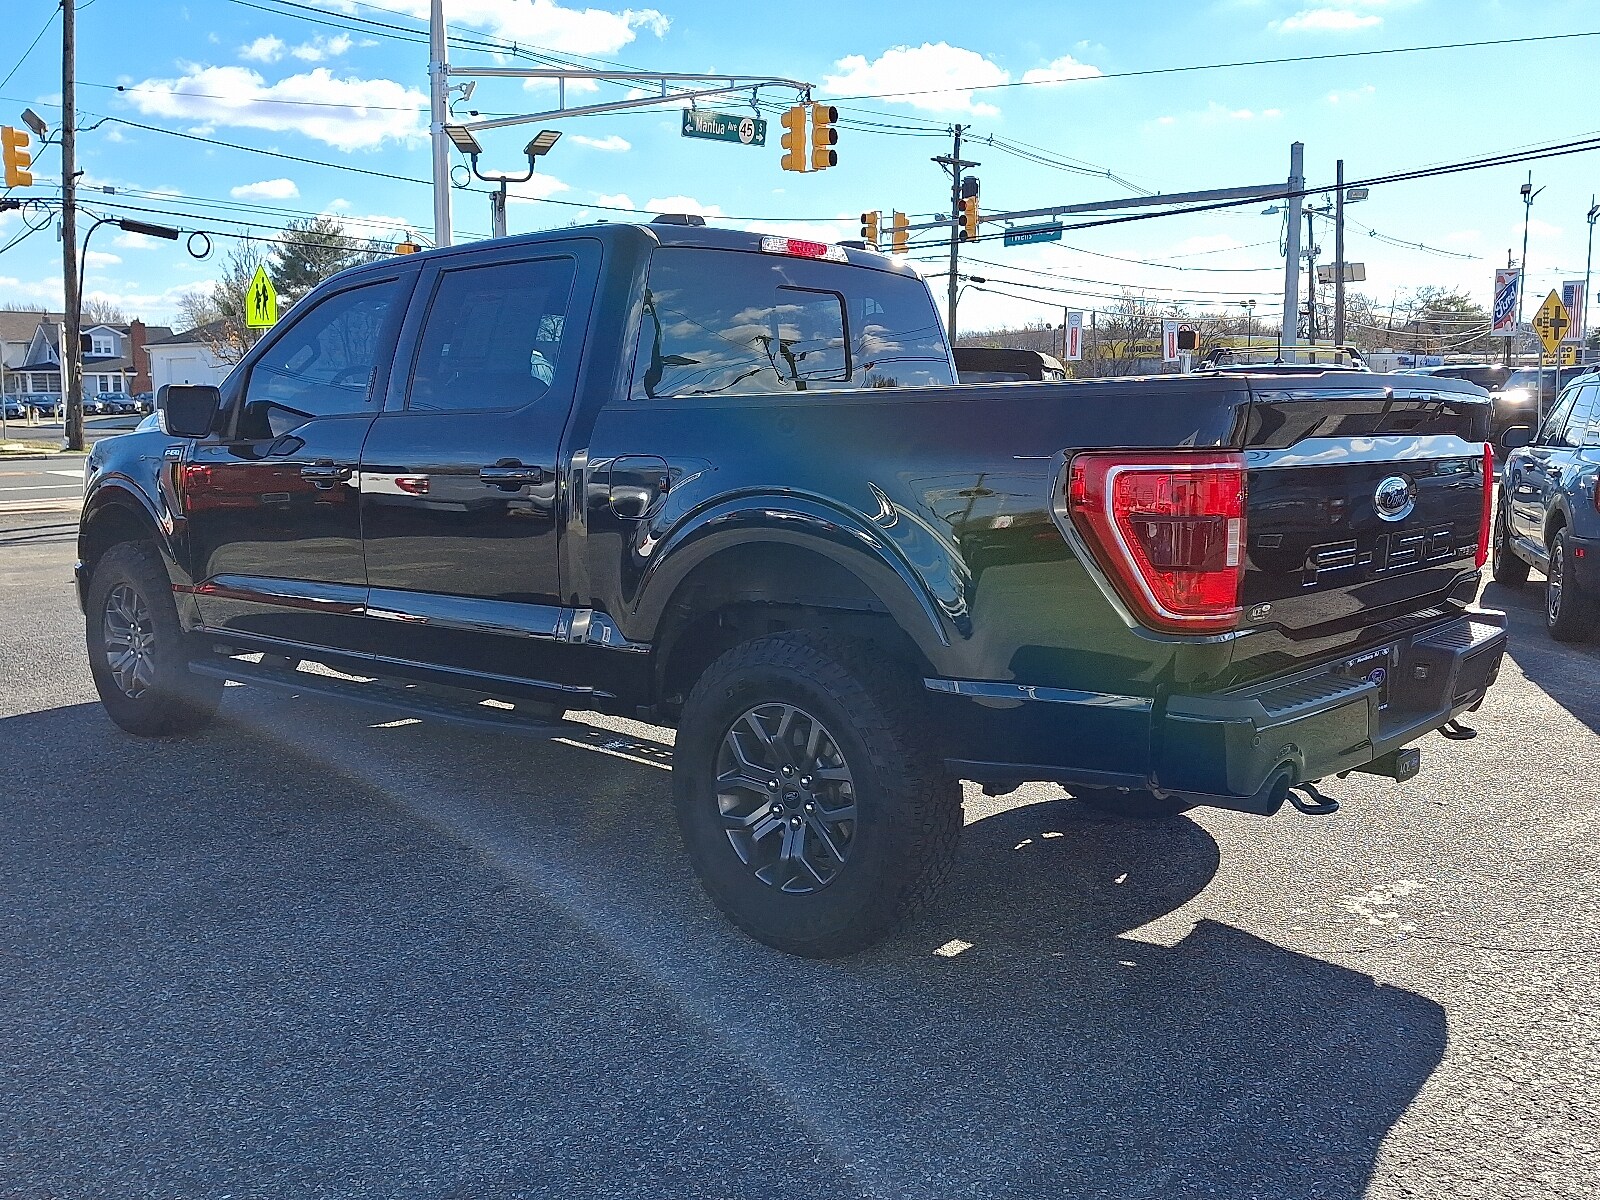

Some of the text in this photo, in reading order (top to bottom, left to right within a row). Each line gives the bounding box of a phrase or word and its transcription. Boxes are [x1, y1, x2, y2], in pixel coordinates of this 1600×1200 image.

[696, 118, 725, 135] Mantua
[727, 121, 737, 132] Ave
[740, 122, 753, 137] 45
[759, 123, 763, 132] S
[1495, 285, 1516, 318] Ford
[1302, 522, 1455, 587] F-150
